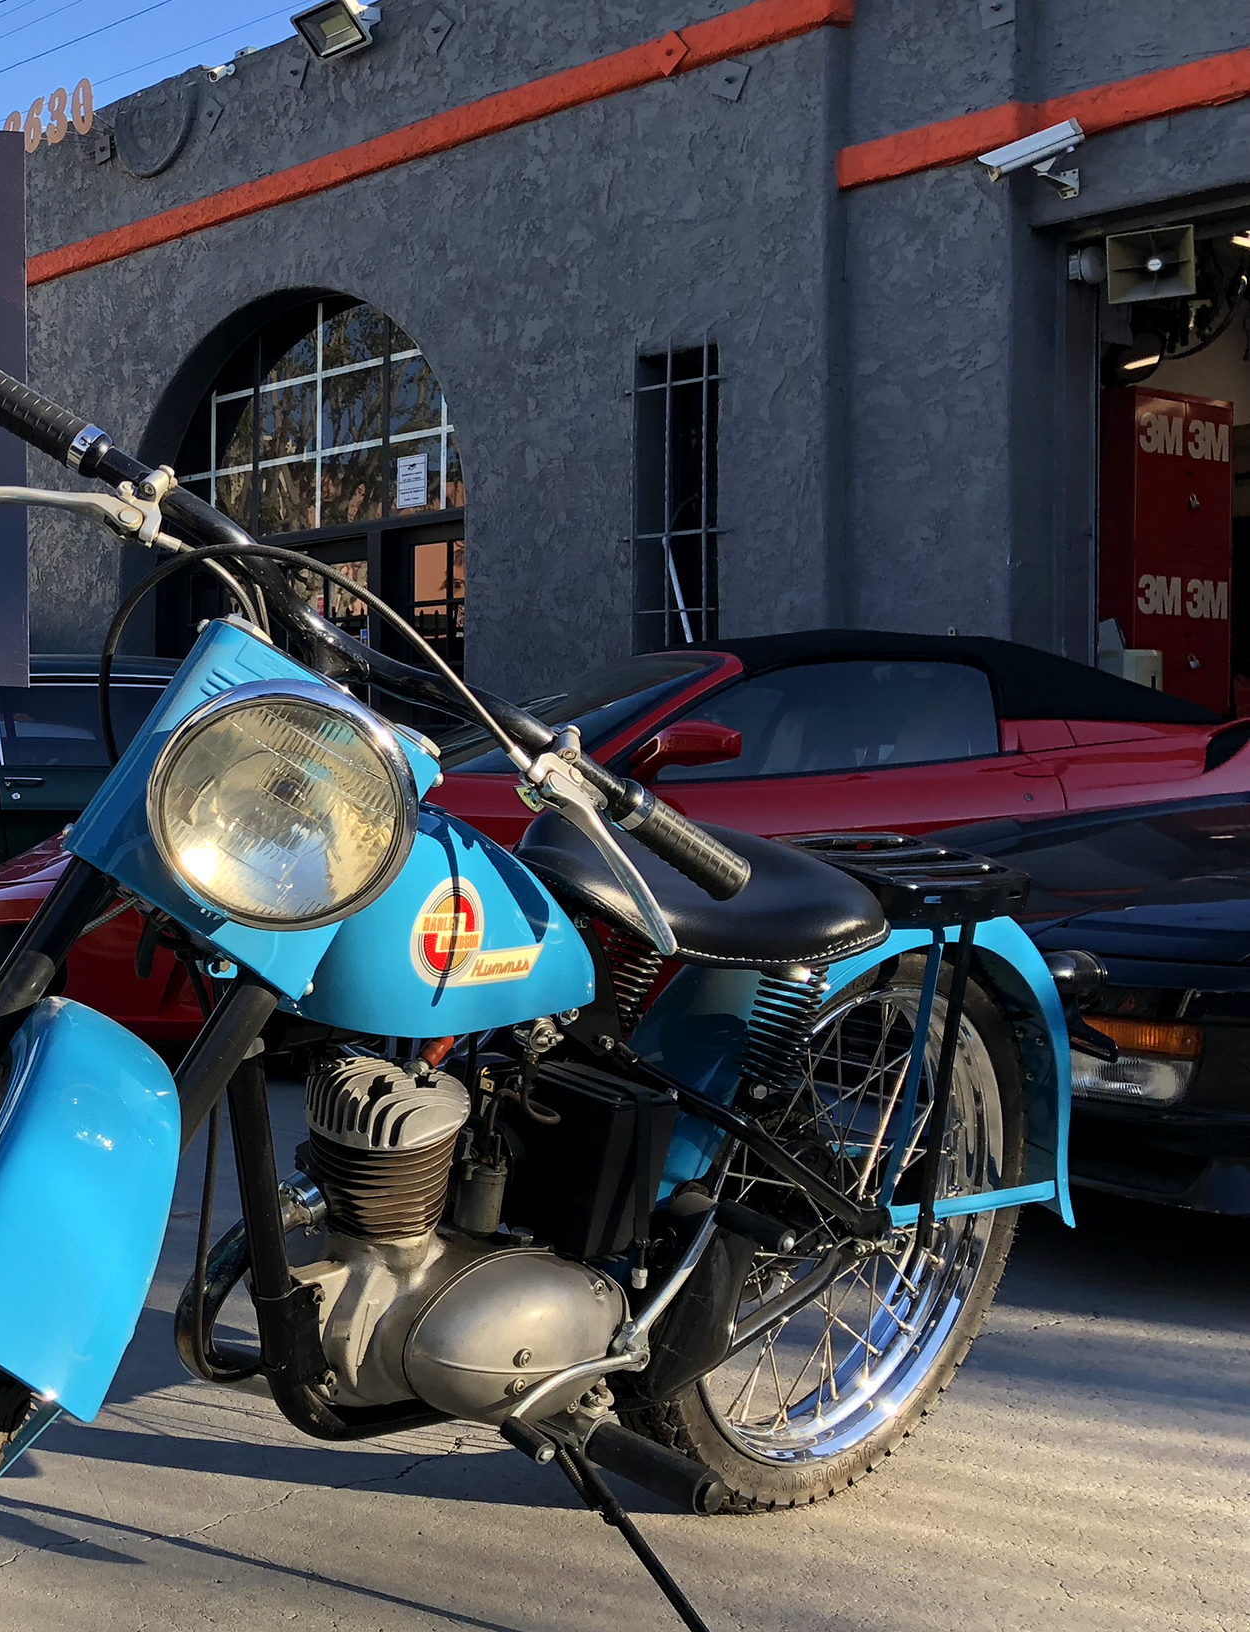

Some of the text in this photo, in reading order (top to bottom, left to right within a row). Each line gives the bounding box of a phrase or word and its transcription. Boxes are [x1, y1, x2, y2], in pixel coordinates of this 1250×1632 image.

[1139, 412, 1230, 462] 3M 3M
[1137, 574, 1228, 620] 3M 3M
[470, 958, 530, 978] Hummer
